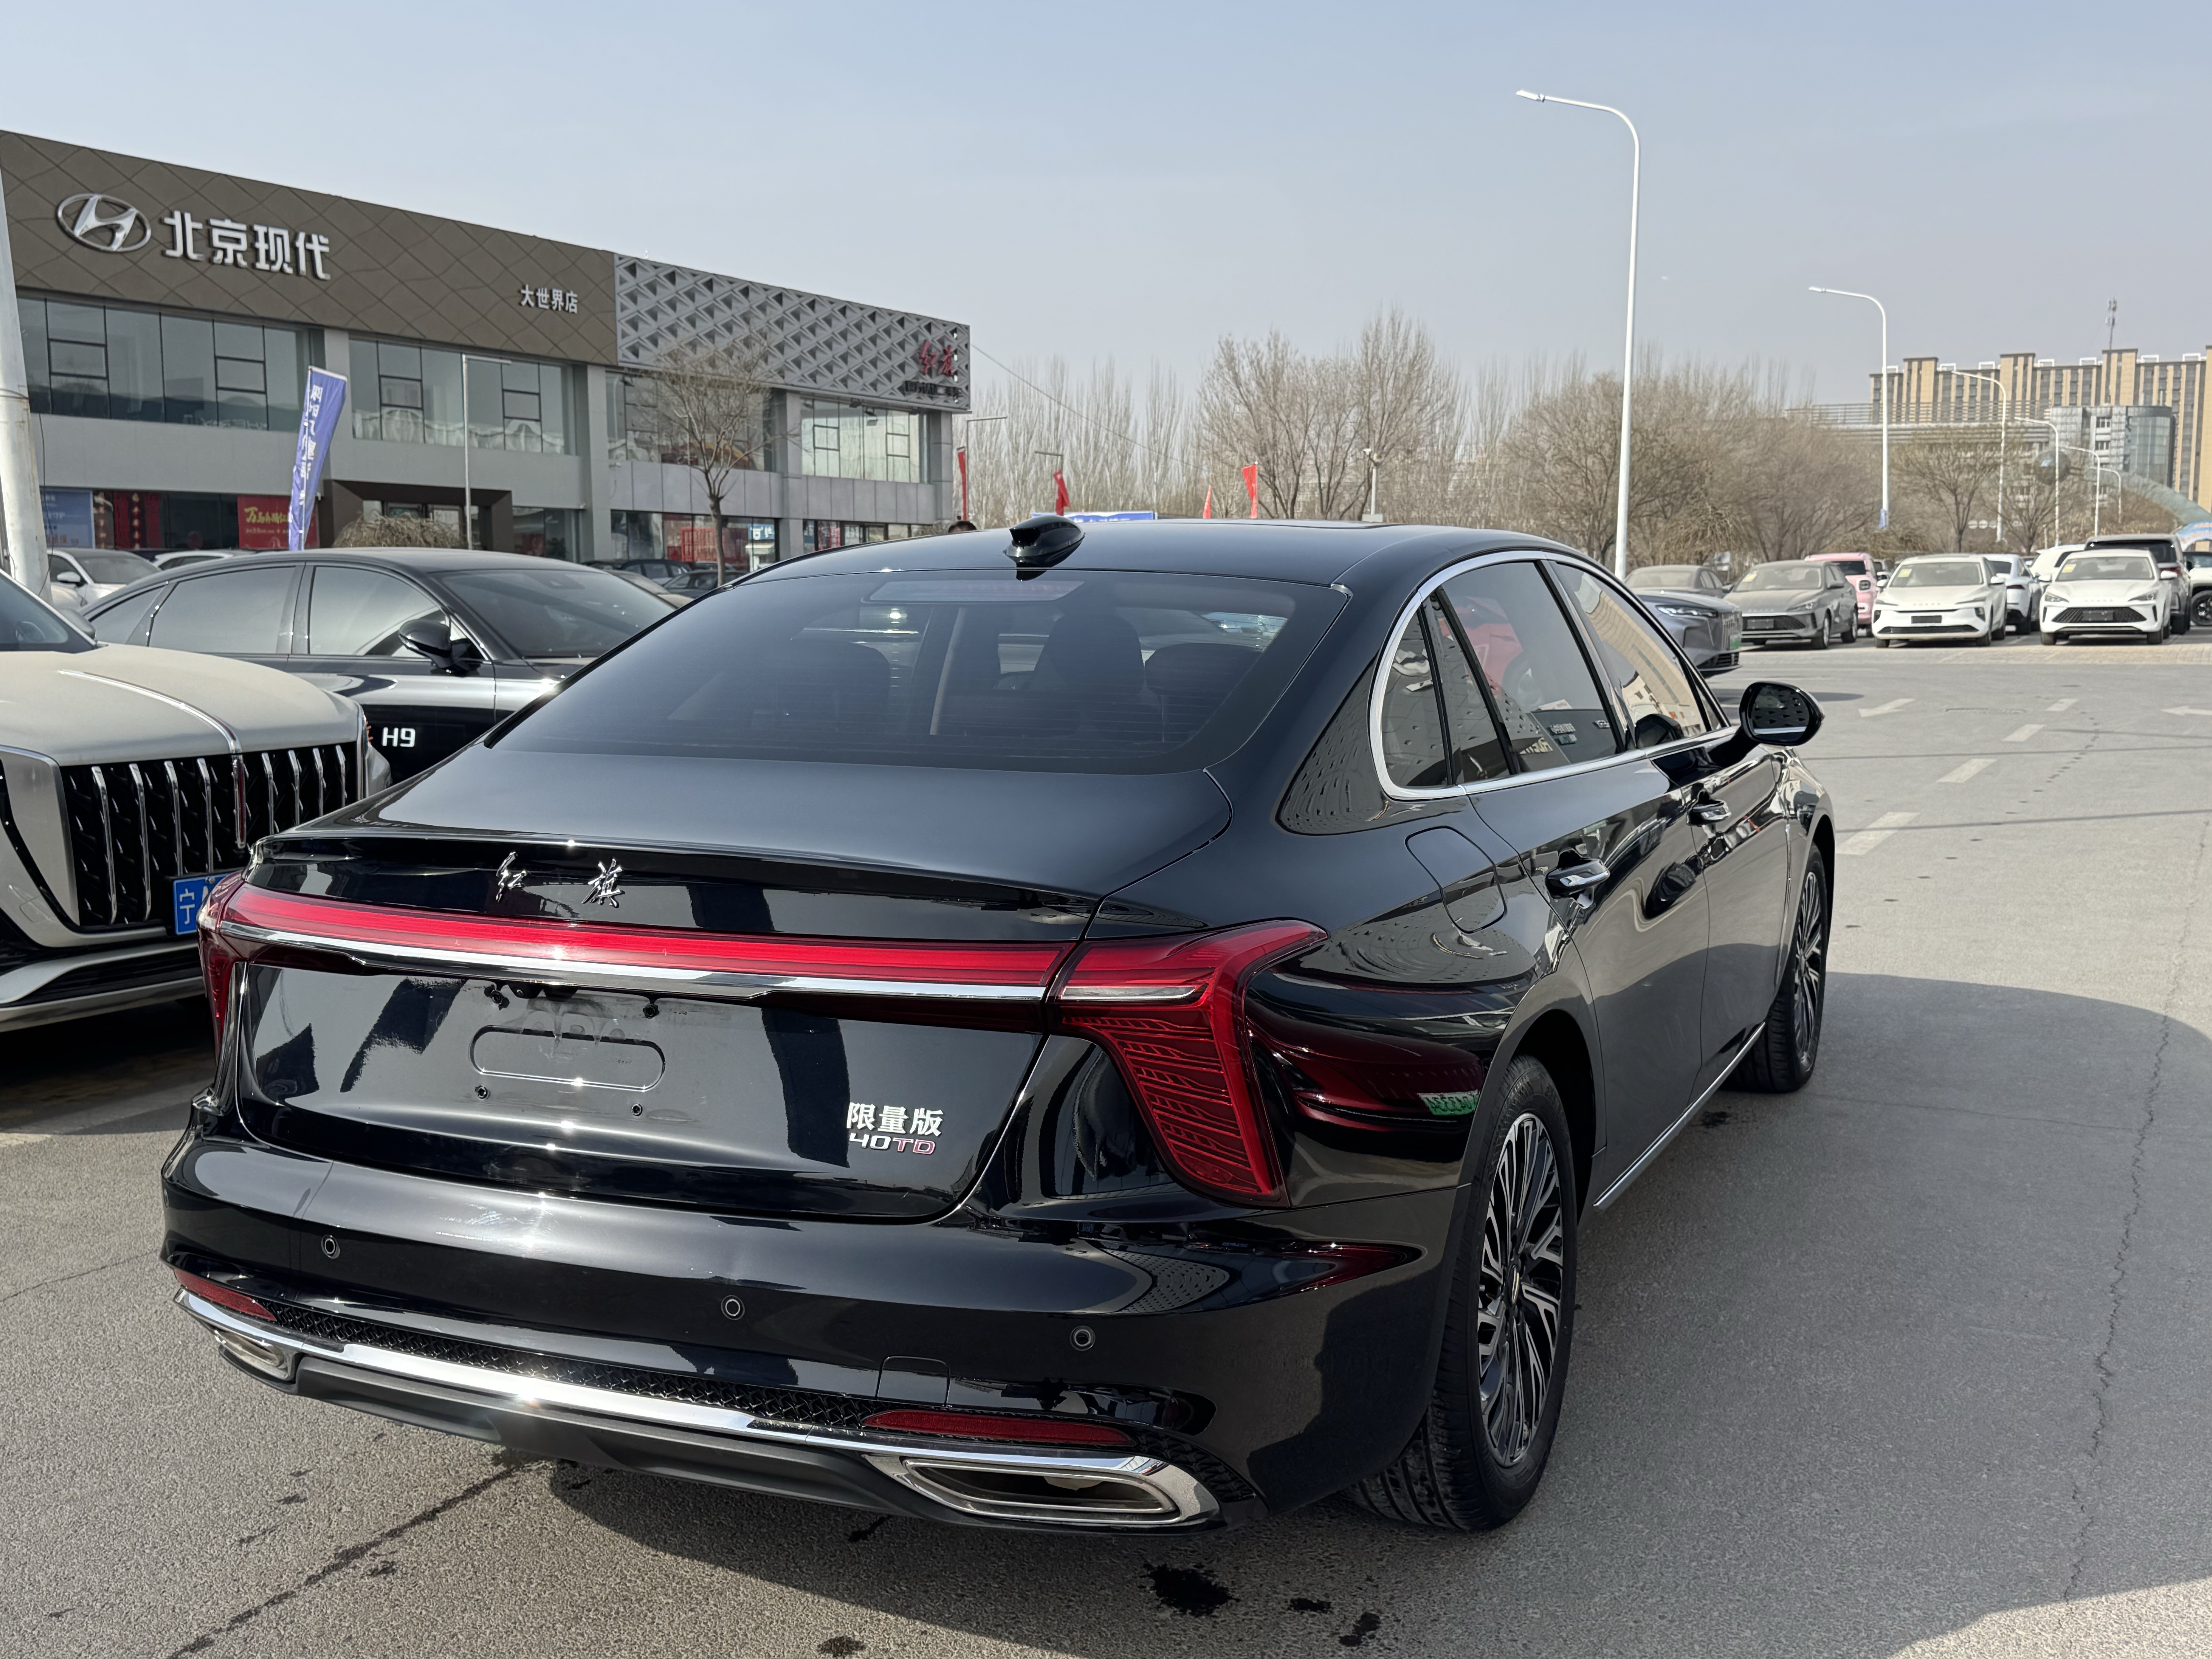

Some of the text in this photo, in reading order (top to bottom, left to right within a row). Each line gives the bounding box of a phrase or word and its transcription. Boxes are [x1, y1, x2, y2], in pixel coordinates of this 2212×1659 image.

[161, 210, 331, 280] 北京现代
[520, 284, 578, 314] 大世界店
[381, 727, 416, 747] H9
[847, 1102, 944, 1137] 限量版
[849, 1132, 936, 1155] 40TD
